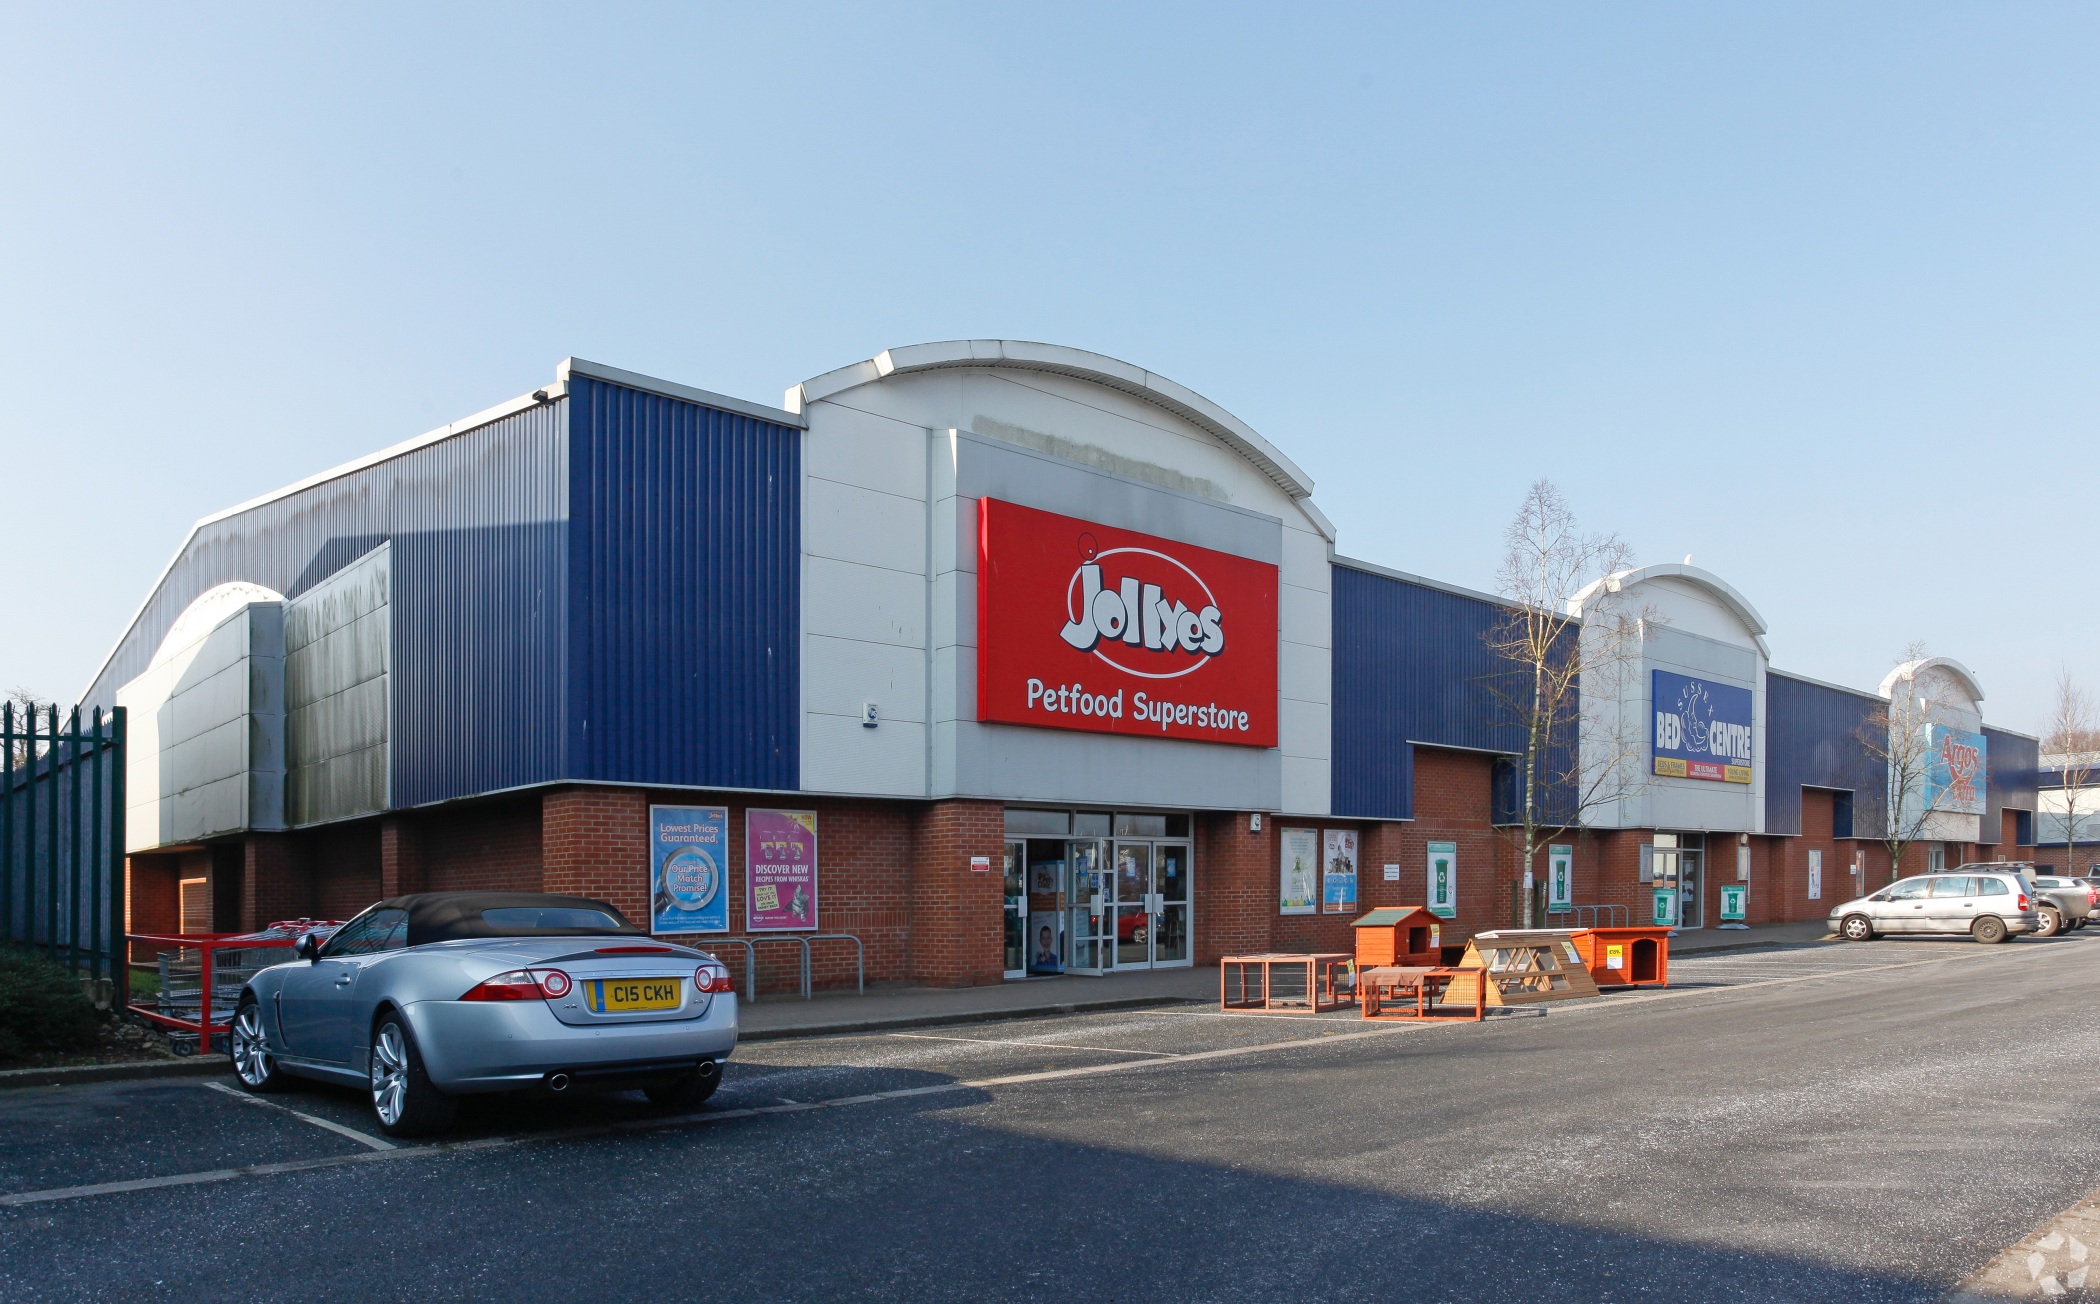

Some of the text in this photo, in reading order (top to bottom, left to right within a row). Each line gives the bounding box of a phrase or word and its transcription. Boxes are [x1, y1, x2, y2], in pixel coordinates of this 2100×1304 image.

[1059, 564, 1224, 655] Jollyes
[1027, 678, 1249, 731] Petfood Superstore
[1656, 711, 1751, 759] BED CENTRE
[1941, 734, 1979, 775] Argos
[660, 822, 718, 833] Lowest Prices
[660, 833, 719, 844] Guaranteed,
[671, 864, 708, 873] Our Price
[755, 864, 809, 874] DISCOVER NEW
[677, 874, 703, 883] Match
[755, 875, 774, 883] RECIPES
[774, 875, 788, 883] FROM
[673, 883, 707, 892] Promise!
[614, 985, 674, 1002] C15 CKH
